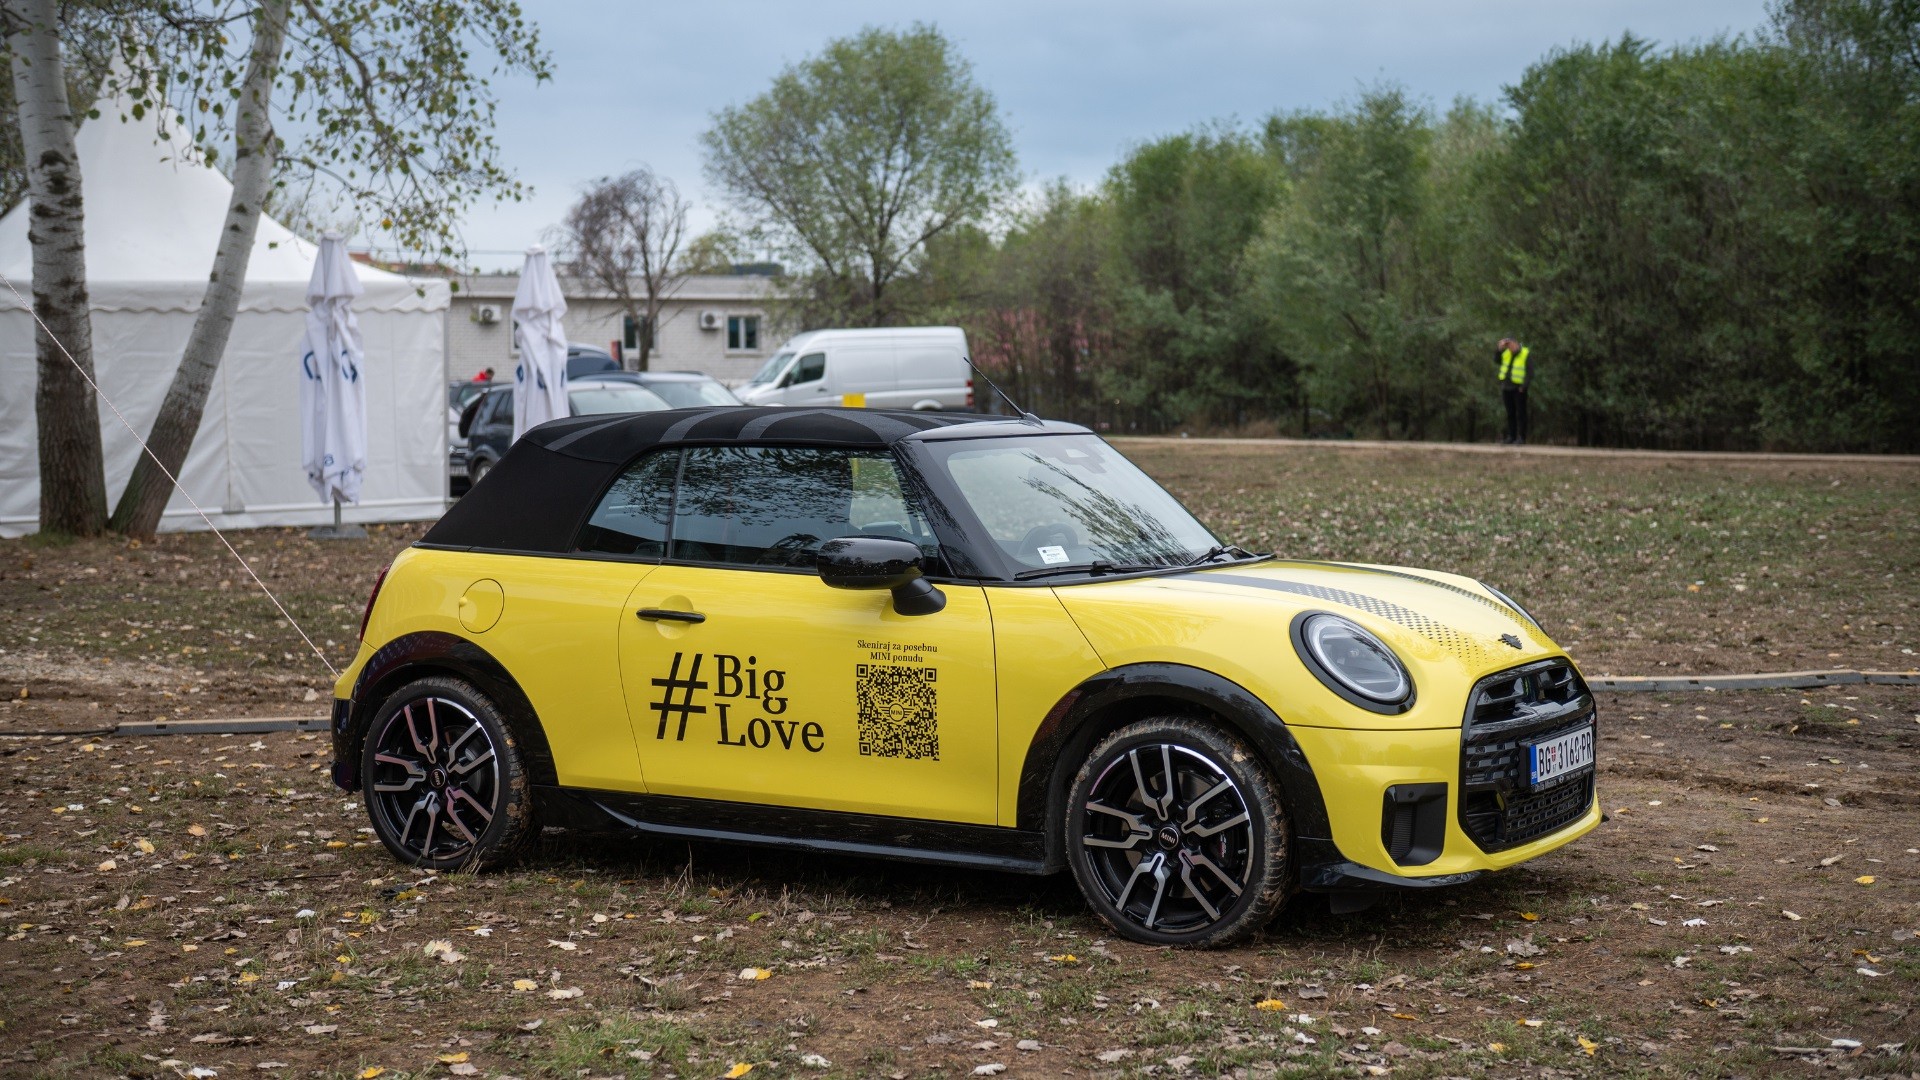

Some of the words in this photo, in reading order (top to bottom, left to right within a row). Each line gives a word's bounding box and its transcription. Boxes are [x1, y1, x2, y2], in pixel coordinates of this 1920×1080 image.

[857, 640, 890, 651] Skeniraj
[892, 643, 902, 651] za
[904, 643, 937, 652] posebnu
[870, 652, 890, 660] MINI
[893, 654, 923, 663] ponudu
[714, 703, 825, 753] Love
[1161, 832, 1175, 844] MINI
